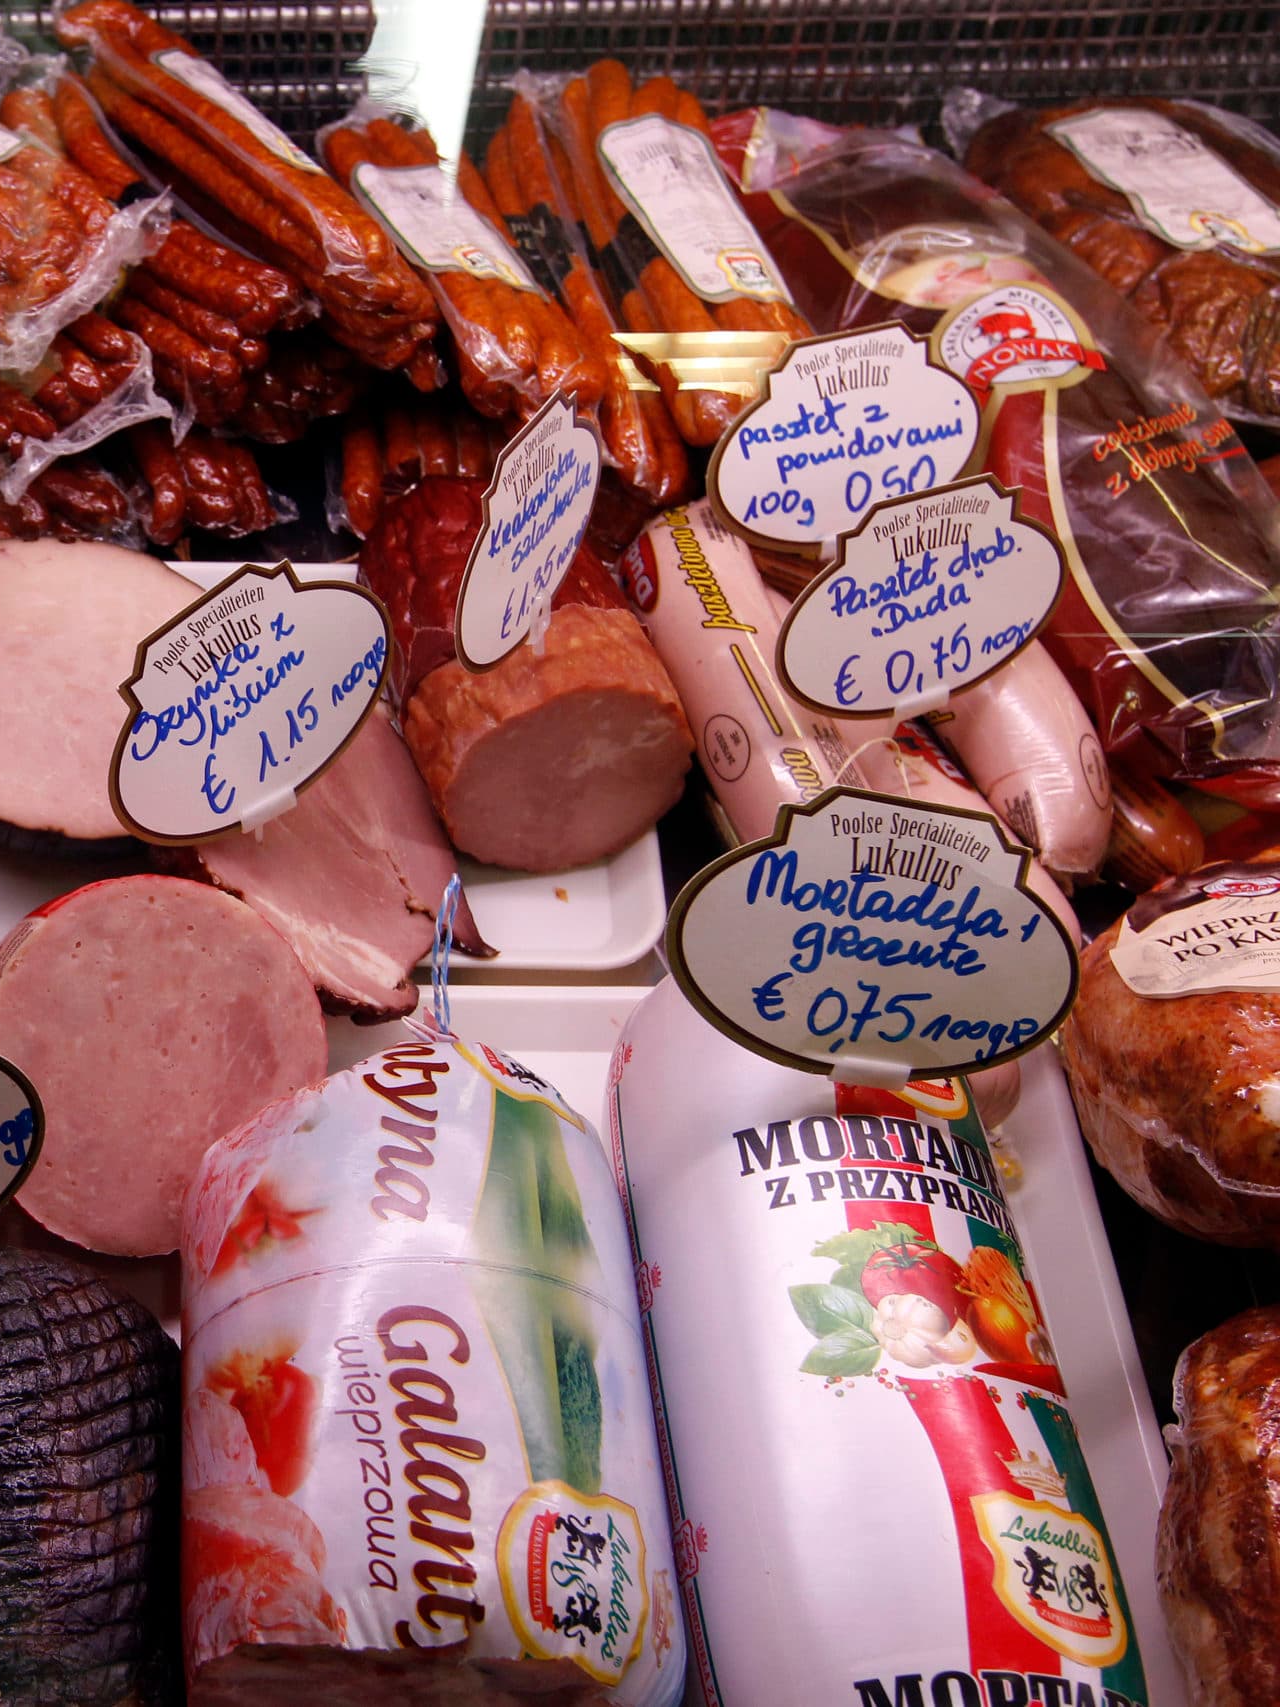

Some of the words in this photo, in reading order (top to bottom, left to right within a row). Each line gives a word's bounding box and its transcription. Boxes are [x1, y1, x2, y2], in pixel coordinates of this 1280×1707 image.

[794, 353, 830, 381] Poolse
[834, 338, 905, 367] Specialiteiten
[813, 359, 891, 401] Lukullus
[974, 341, 1076, 381] NOWAK
[503, 456, 524, 492] Poolse
[523, 415, 563, 461] Specialiteiten
[513, 443, 557, 506] Lukullus
[742, 488, 816, 527] 100g
[873, 512, 912, 544] Poolse
[915, 494, 991, 525] Specialiteiten
[890, 517, 973, 564] Lukullus
[153, 633, 190, 675] Poolse
[187, 586, 265, 639] Specialiteiten
[175, 613, 262, 684] Lukullus
[833, 654, 864, 706] €
[200, 753, 236, 814] €
[830, 813, 884, 838] Poolse
[889, 811, 993, 865] Specialiteiten
[849, 836, 964, 892] Lukullus
[1173, 941, 1222, 963] PO
[751, 972, 795, 1022] €
[764, 1178, 796, 1210] Z
[332, 1334, 398, 1592] wieprzowa
[1000, 1515, 1100, 1562] Lukullus
[600, 1513, 632, 1660] Lukullus
